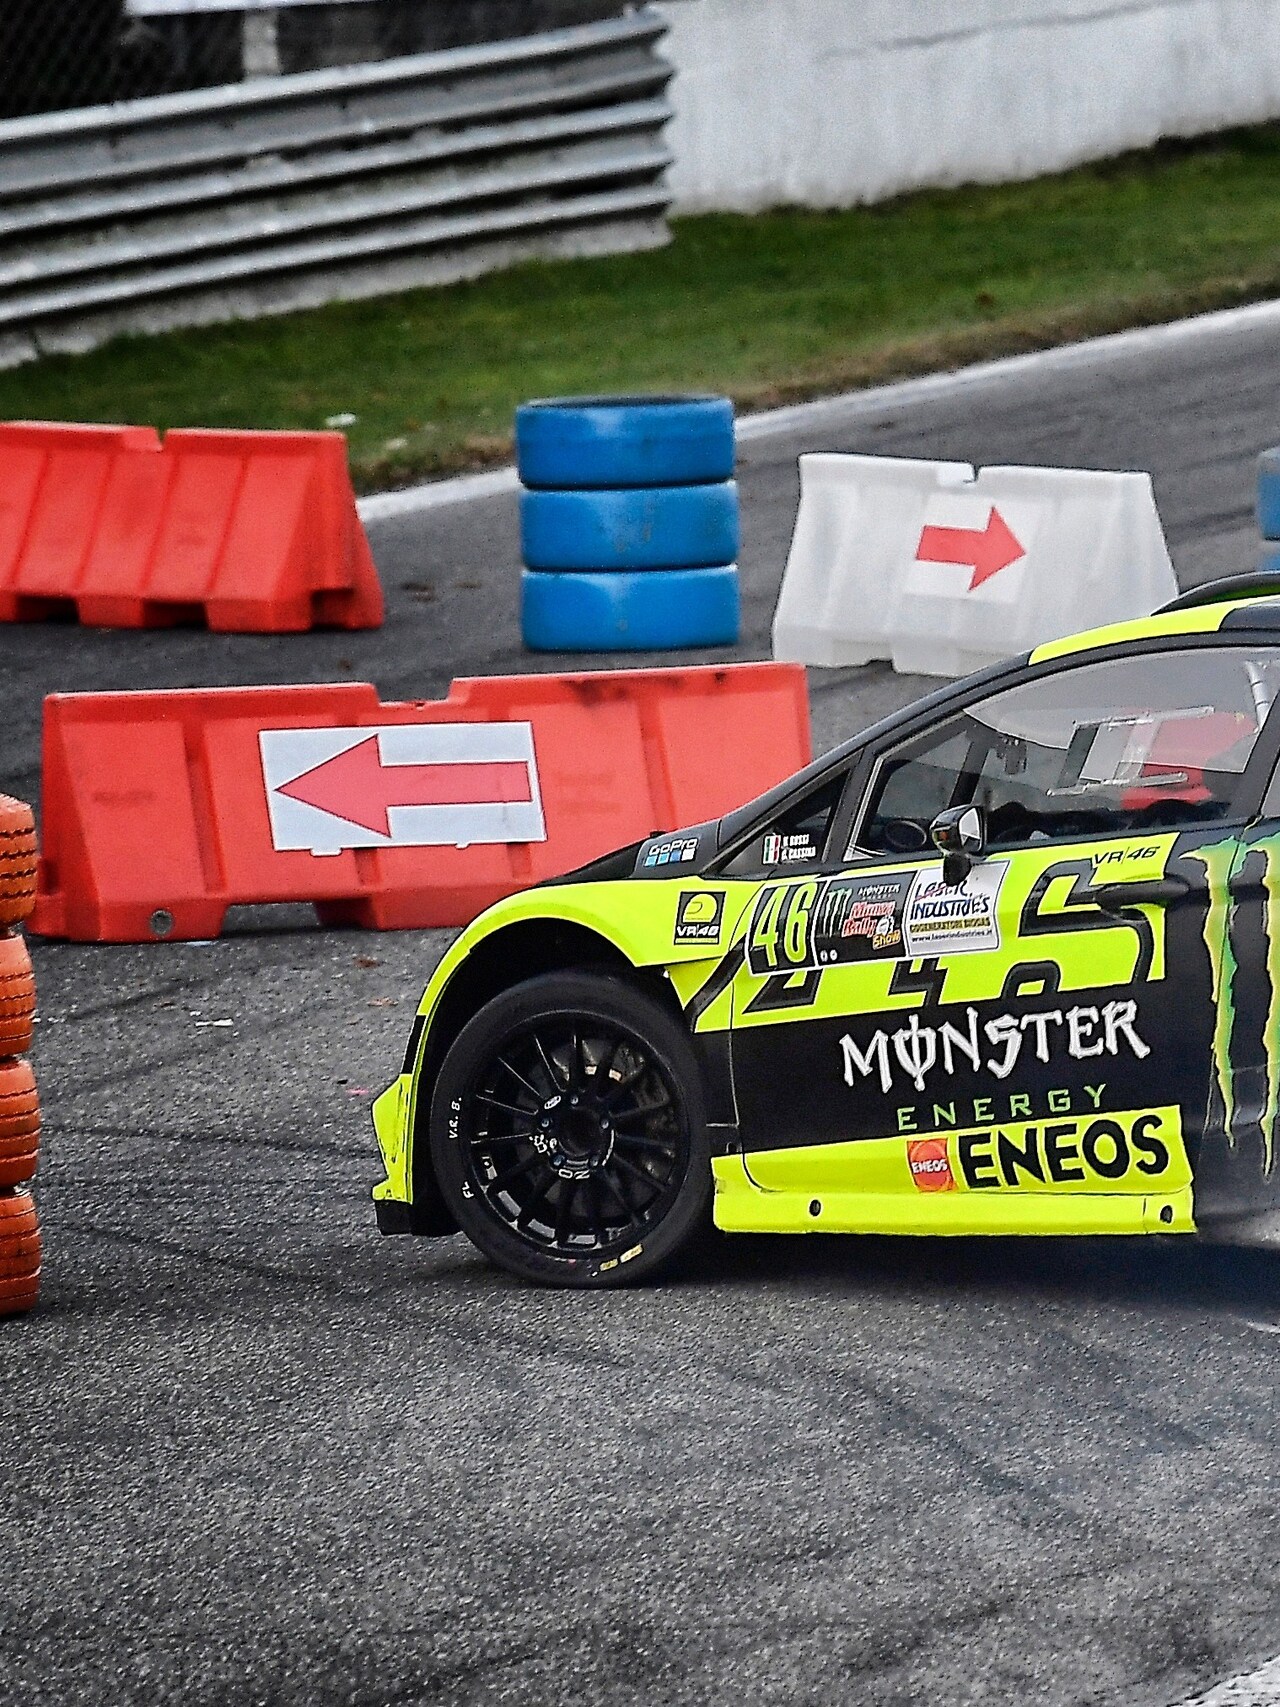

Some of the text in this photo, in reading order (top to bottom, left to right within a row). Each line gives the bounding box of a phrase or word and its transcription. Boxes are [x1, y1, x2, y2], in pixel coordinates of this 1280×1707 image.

[649, 837, 698, 856] GoPro
[753, 881, 818, 966] 46
[910, 896, 990, 921] INDUSTRIES
[896, 1083, 1107, 1132] ENERGY
[911, 1158, 948, 1174] ENEOS
[957, 1114, 1170, 1190] ENEOS
